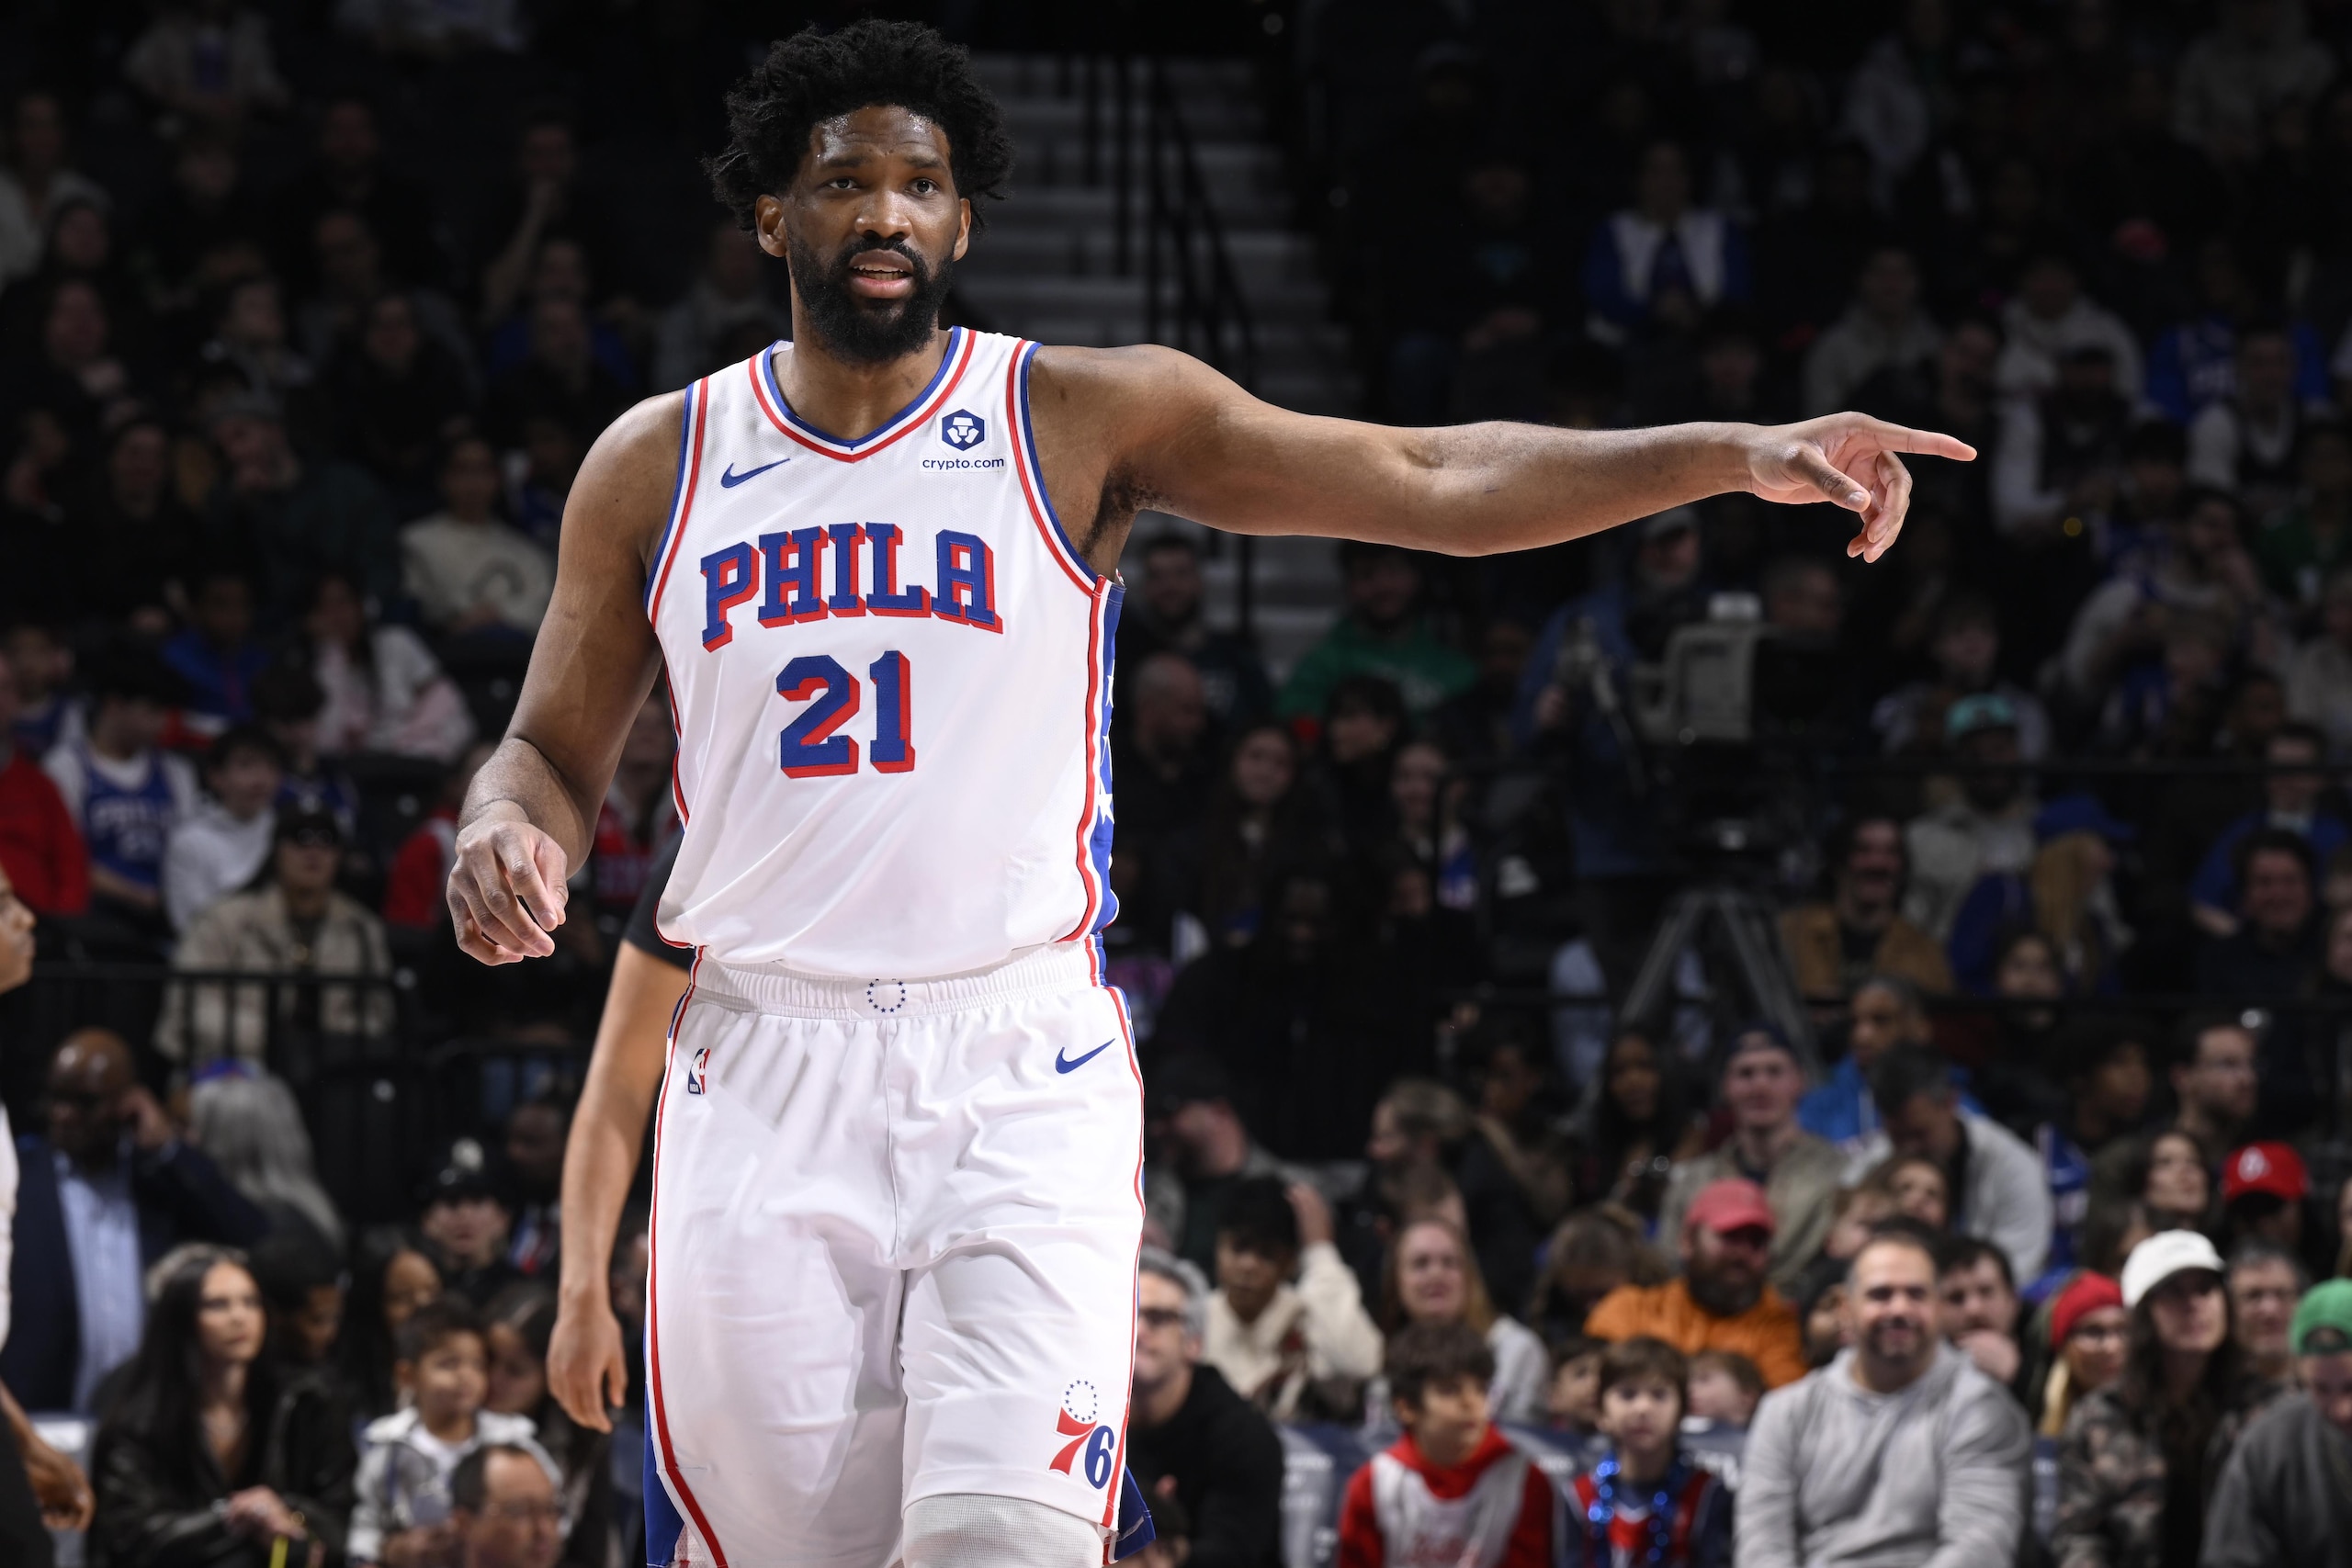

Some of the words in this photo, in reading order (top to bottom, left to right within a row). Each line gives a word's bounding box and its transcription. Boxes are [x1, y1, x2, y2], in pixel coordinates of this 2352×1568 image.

[922, 458, 1004, 470] crypto.com
[700, 522, 1003, 653] PHILA
[775, 649, 915, 779] 21
[1048, 1405, 1114, 1490] 76
